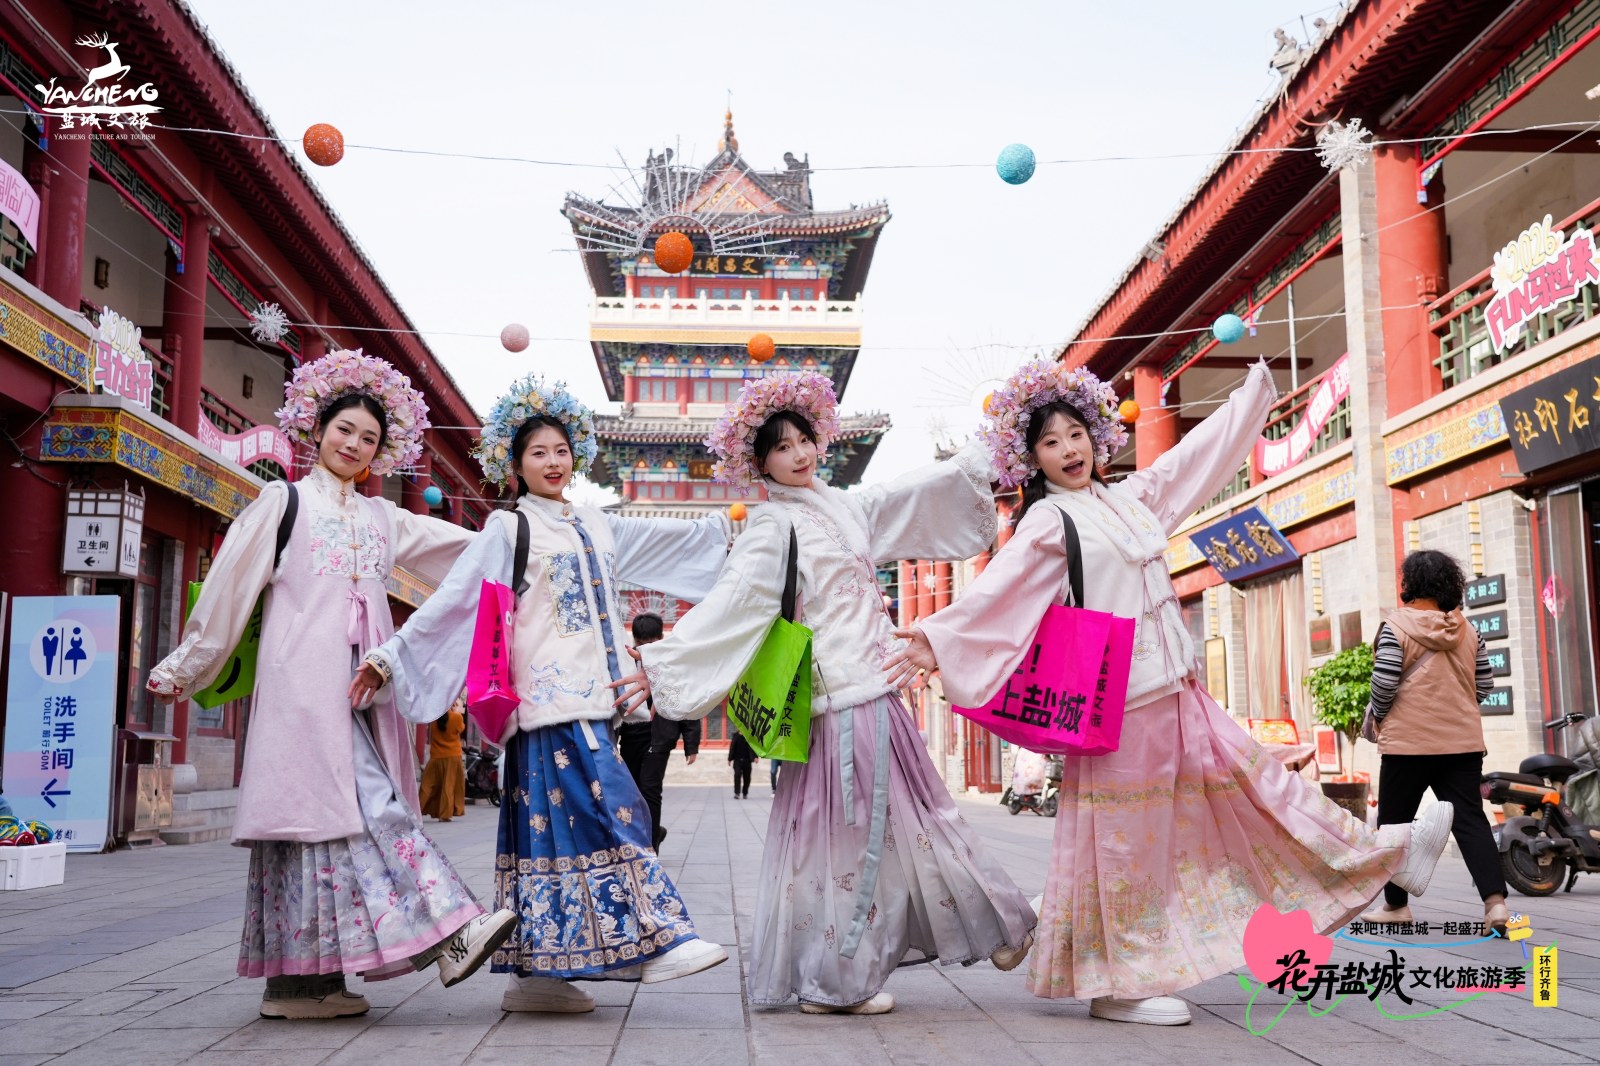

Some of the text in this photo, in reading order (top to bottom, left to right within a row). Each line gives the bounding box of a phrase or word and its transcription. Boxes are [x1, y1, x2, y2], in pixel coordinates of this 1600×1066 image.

[1507, 215, 1556, 283] 2026
[111, 312, 142, 363] 2026
[95, 340, 152, 409] 马力全开
[1513, 376, 1600, 450] 石印社
[77, 540, 109, 550] 卫生间
[43, 696, 52, 726] TOILET
[52, 695, 77, 770] 洗手间
